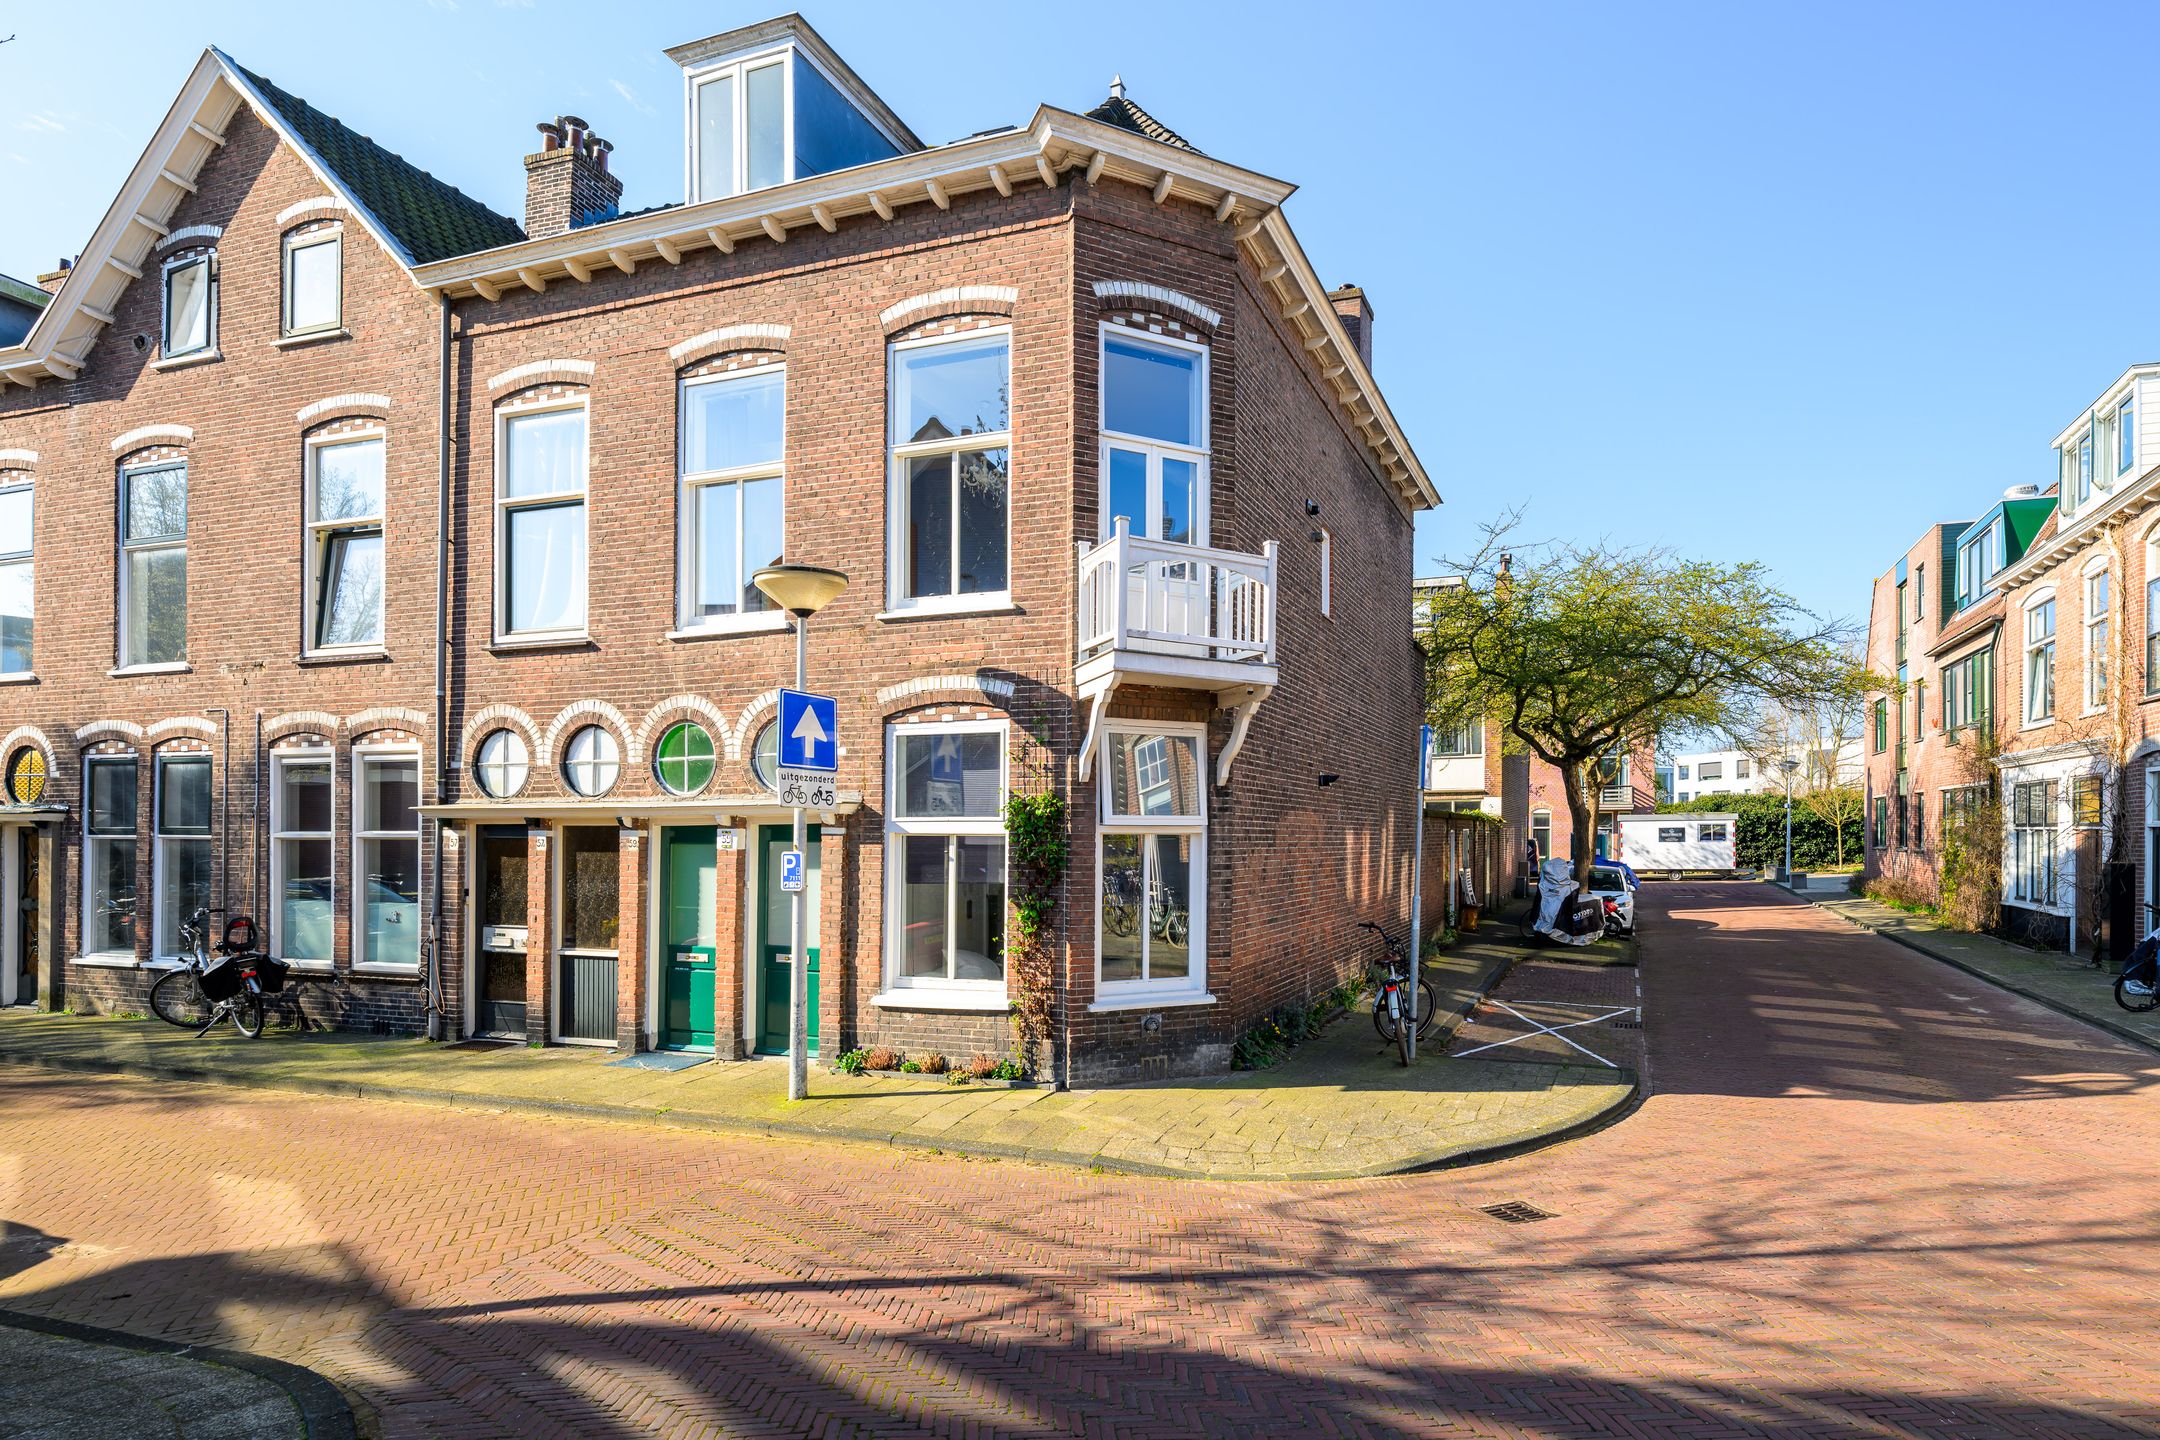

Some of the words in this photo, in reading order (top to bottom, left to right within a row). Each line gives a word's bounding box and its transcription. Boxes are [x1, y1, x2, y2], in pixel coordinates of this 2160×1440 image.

[781, 772, 835, 784] uitgezonderd
[450, 838, 458, 847] 57
[784, 855, 797, 876] P
